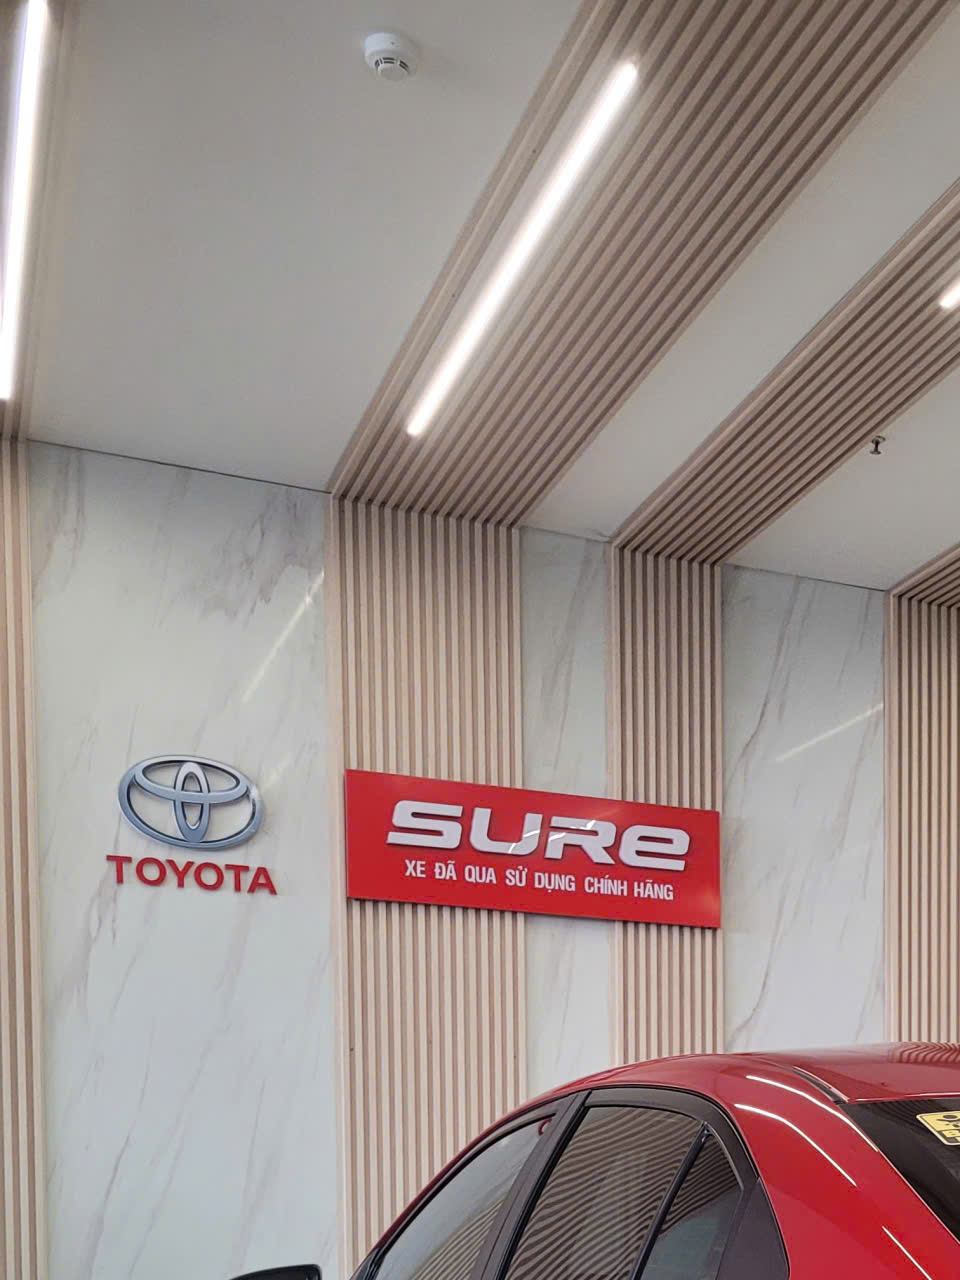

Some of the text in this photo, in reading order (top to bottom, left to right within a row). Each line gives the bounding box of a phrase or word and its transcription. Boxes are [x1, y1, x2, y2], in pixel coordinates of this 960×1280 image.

[106, 855, 277, 895] TOYOTA
[405, 859, 674, 901] XE ĐÃ QUA SỬ DỤNG CHÍNH HÃNG
